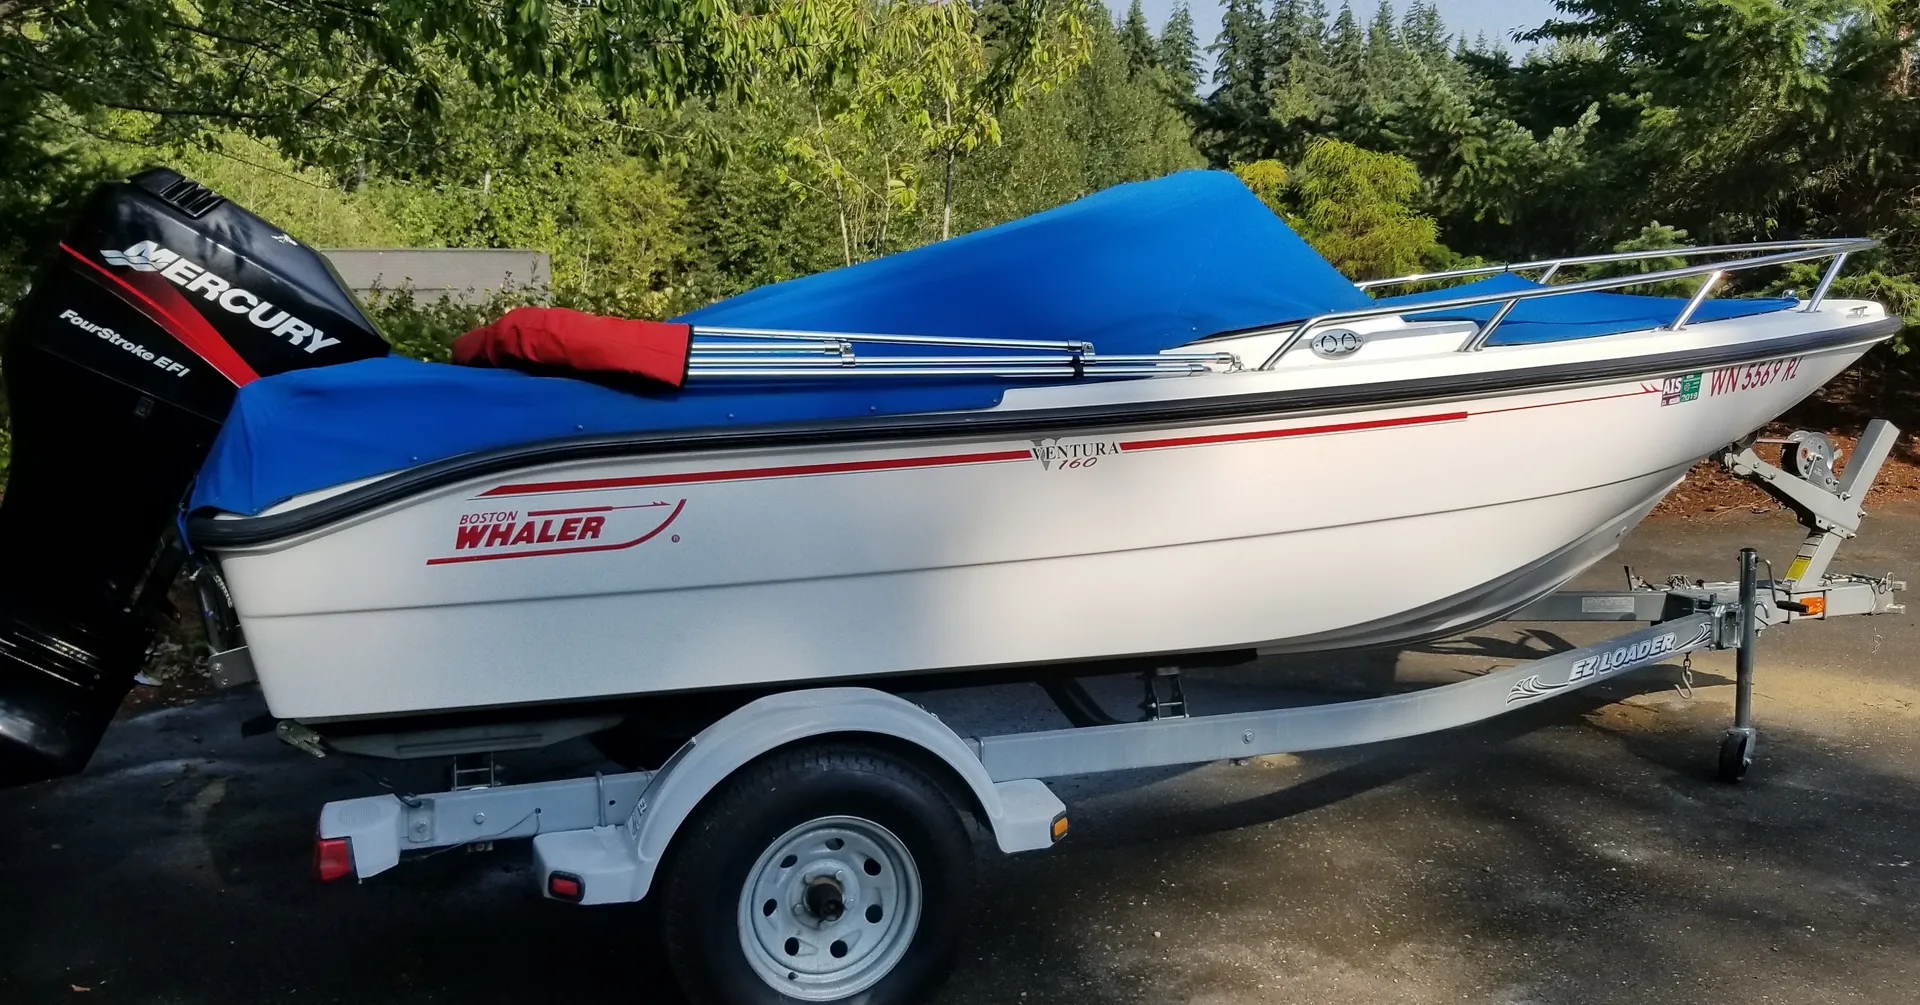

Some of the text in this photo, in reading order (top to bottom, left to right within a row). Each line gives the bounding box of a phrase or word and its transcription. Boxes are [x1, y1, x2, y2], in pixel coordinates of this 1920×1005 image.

[101, 240, 341, 354] MERCURY
[59, 309, 191, 377] FourStroke EFI
[1663, 377, 1682, 395] AIS
[1710, 366, 1743, 397] WN
[1741, 360, 1784, 390] 5569
[1781, 356, 1804, 382] RL
[1681, 392, 1698, 401] 2019
[1031, 440, 1119, 461] VENTURA
[1058, 457, 1098, 470] 160
[459, 510, 519, 525] BOSTON
[455, 516, 606, 550] WHALER
[1568, 632, 1676, 683] EZ LOADER
